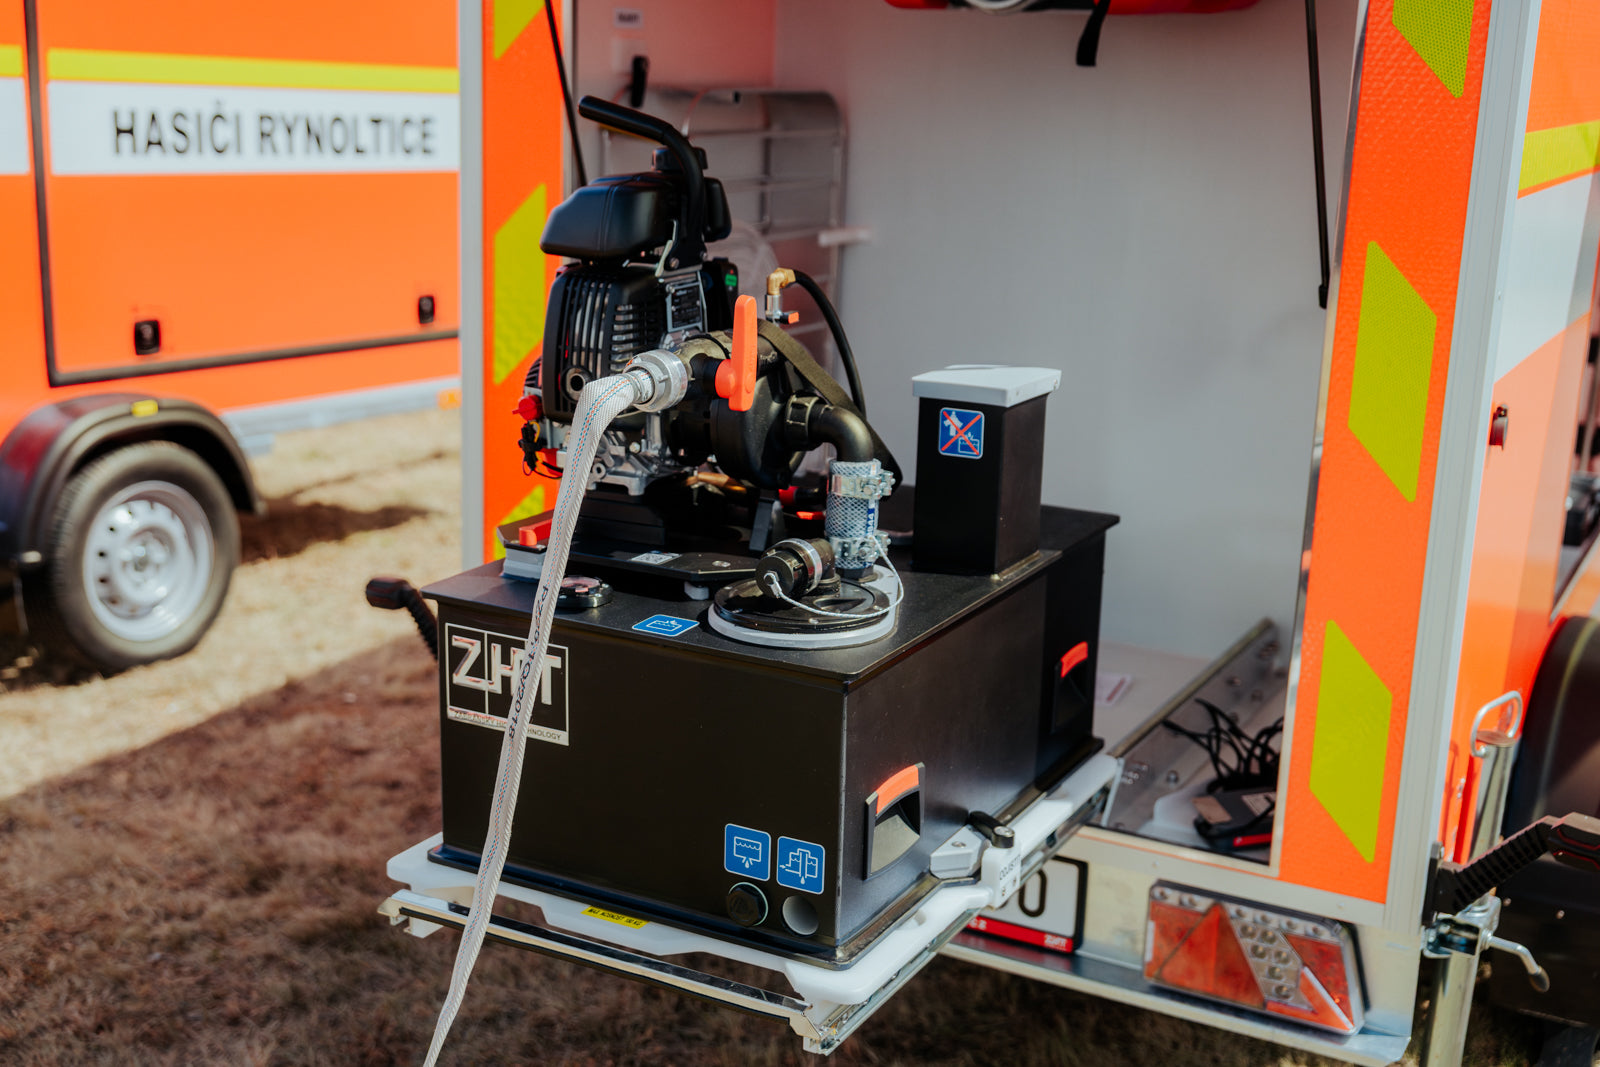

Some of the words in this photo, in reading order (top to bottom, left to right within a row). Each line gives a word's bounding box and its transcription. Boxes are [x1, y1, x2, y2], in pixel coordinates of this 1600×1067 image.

[113, 99, 243, 155] HASIČI
[258, 110, 436, 156] RYNOLTICE
[452, 634, 562, 706] ZHT
